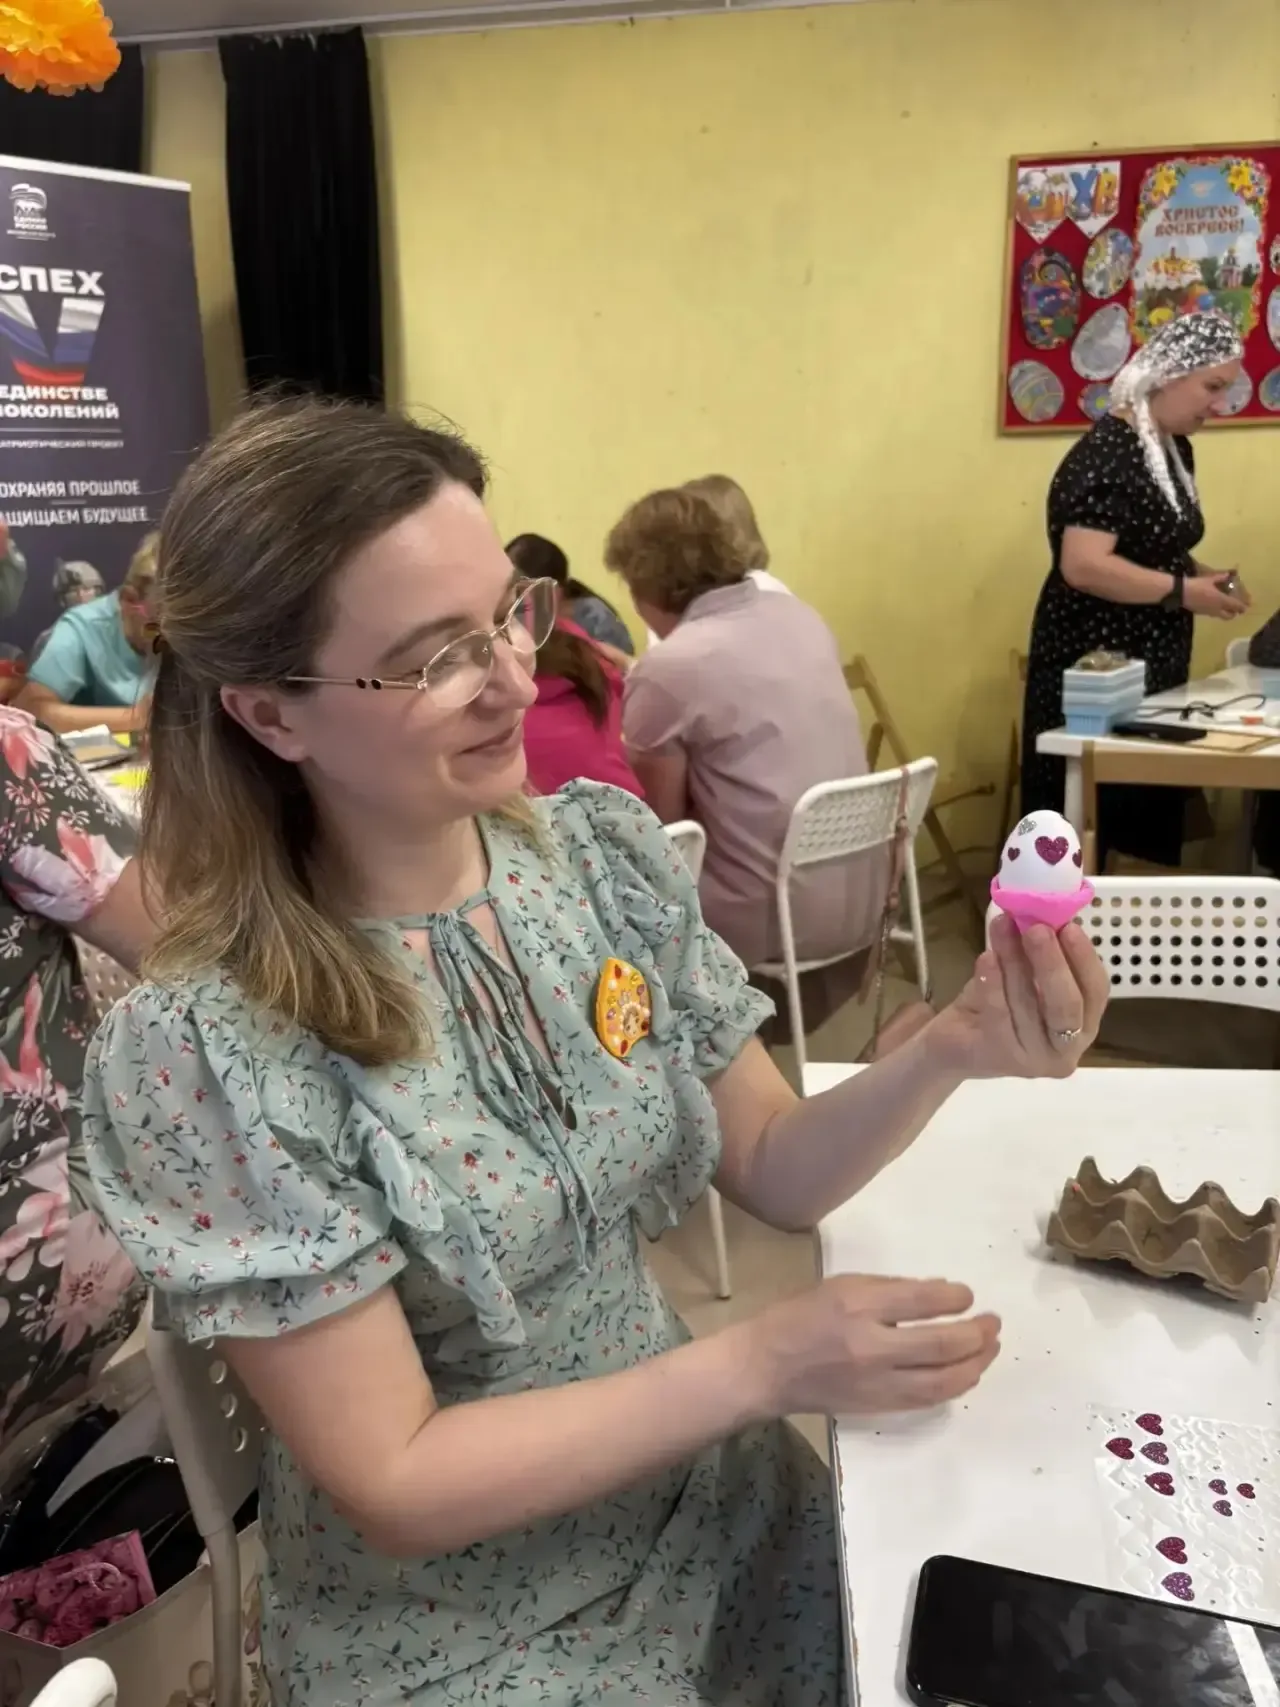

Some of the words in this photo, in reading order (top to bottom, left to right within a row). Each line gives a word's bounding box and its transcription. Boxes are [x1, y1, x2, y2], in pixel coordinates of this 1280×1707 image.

[0, 384, 108, 401] ЕДИНСТВЕ
[0, 481, 66, 498] ОХРАНЯЯ
[69, 479, 140, 496] ПРОШЛОЕ
[83, 506, 148, 524] БУДУЩЕЕ
